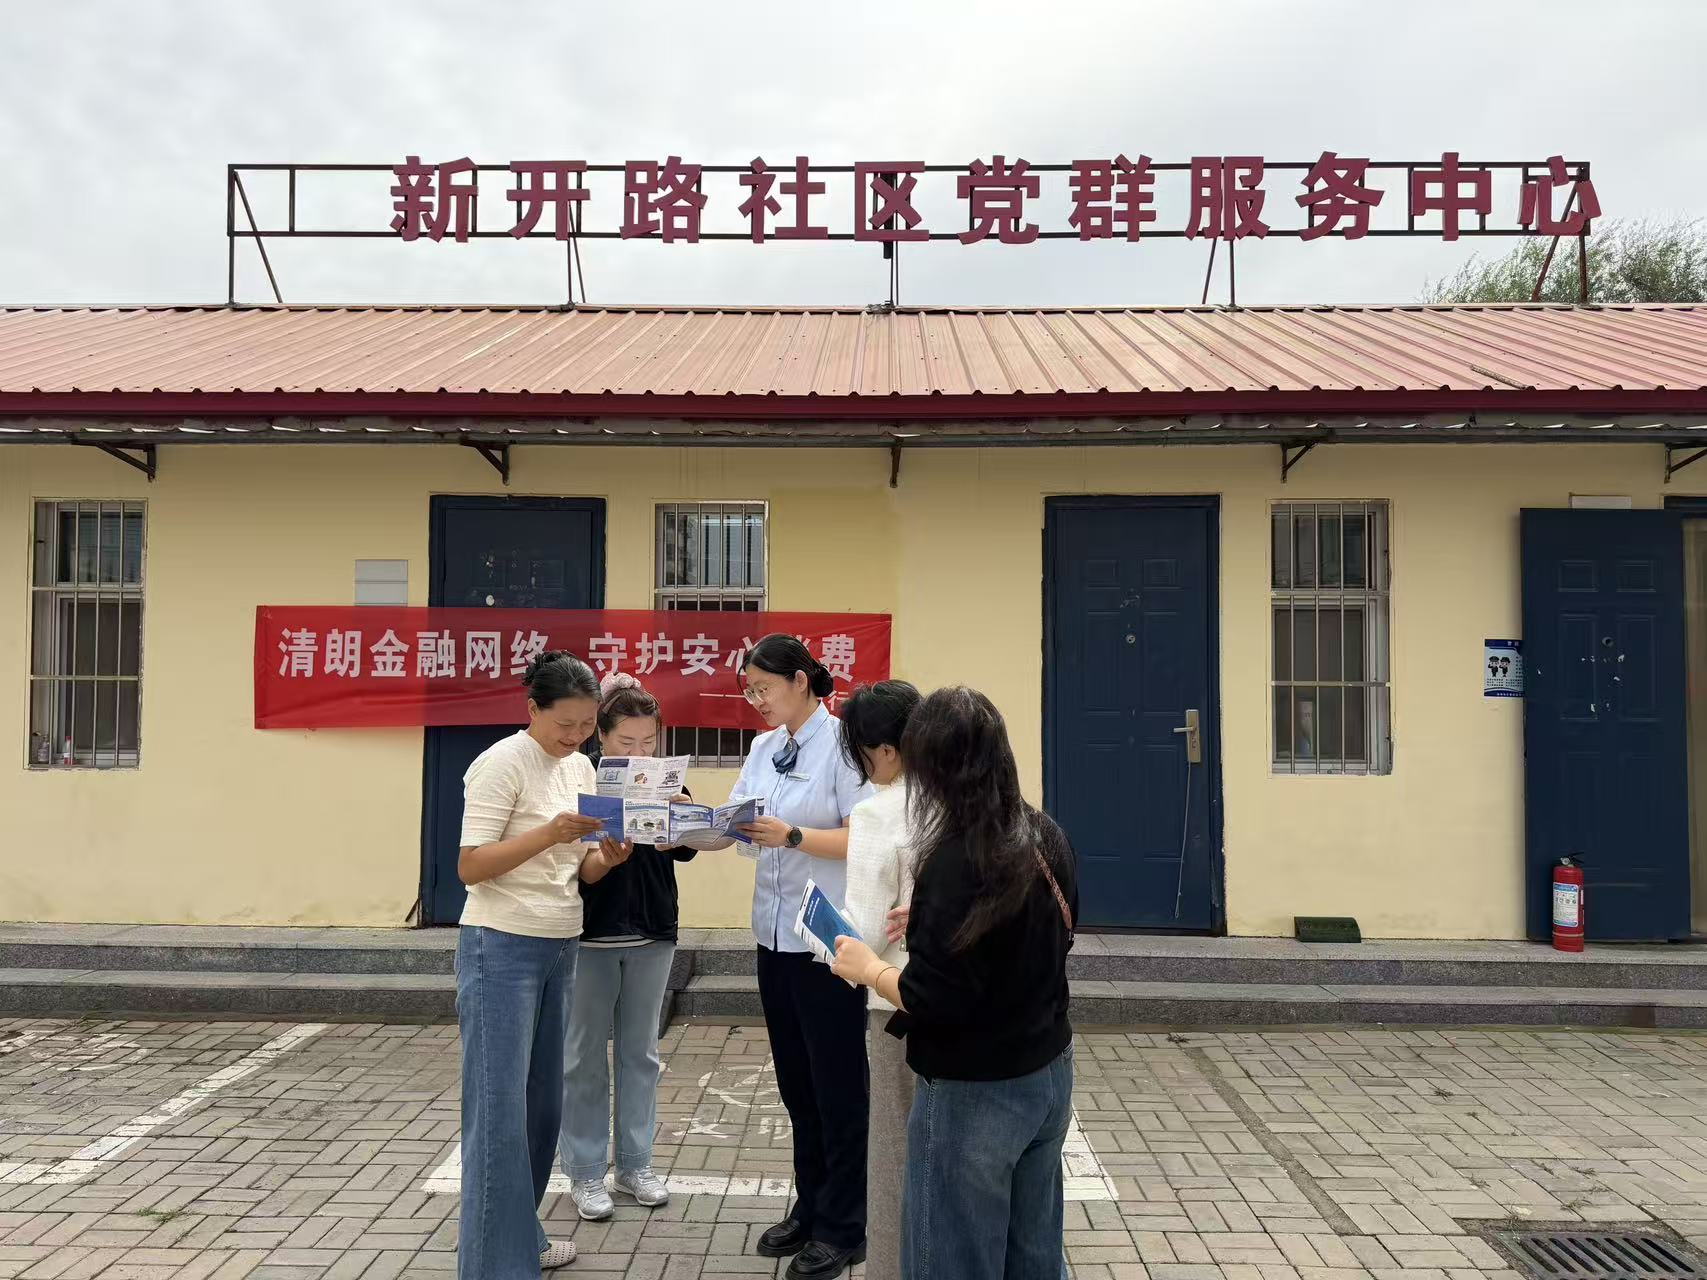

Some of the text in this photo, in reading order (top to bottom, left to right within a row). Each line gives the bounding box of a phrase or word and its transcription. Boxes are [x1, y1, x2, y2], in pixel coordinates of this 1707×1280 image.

[390, 152, 1602, 243] 新开路社区党群服务中心
[278, 628, 856, 682] 清朗金融网络 守护安心费
